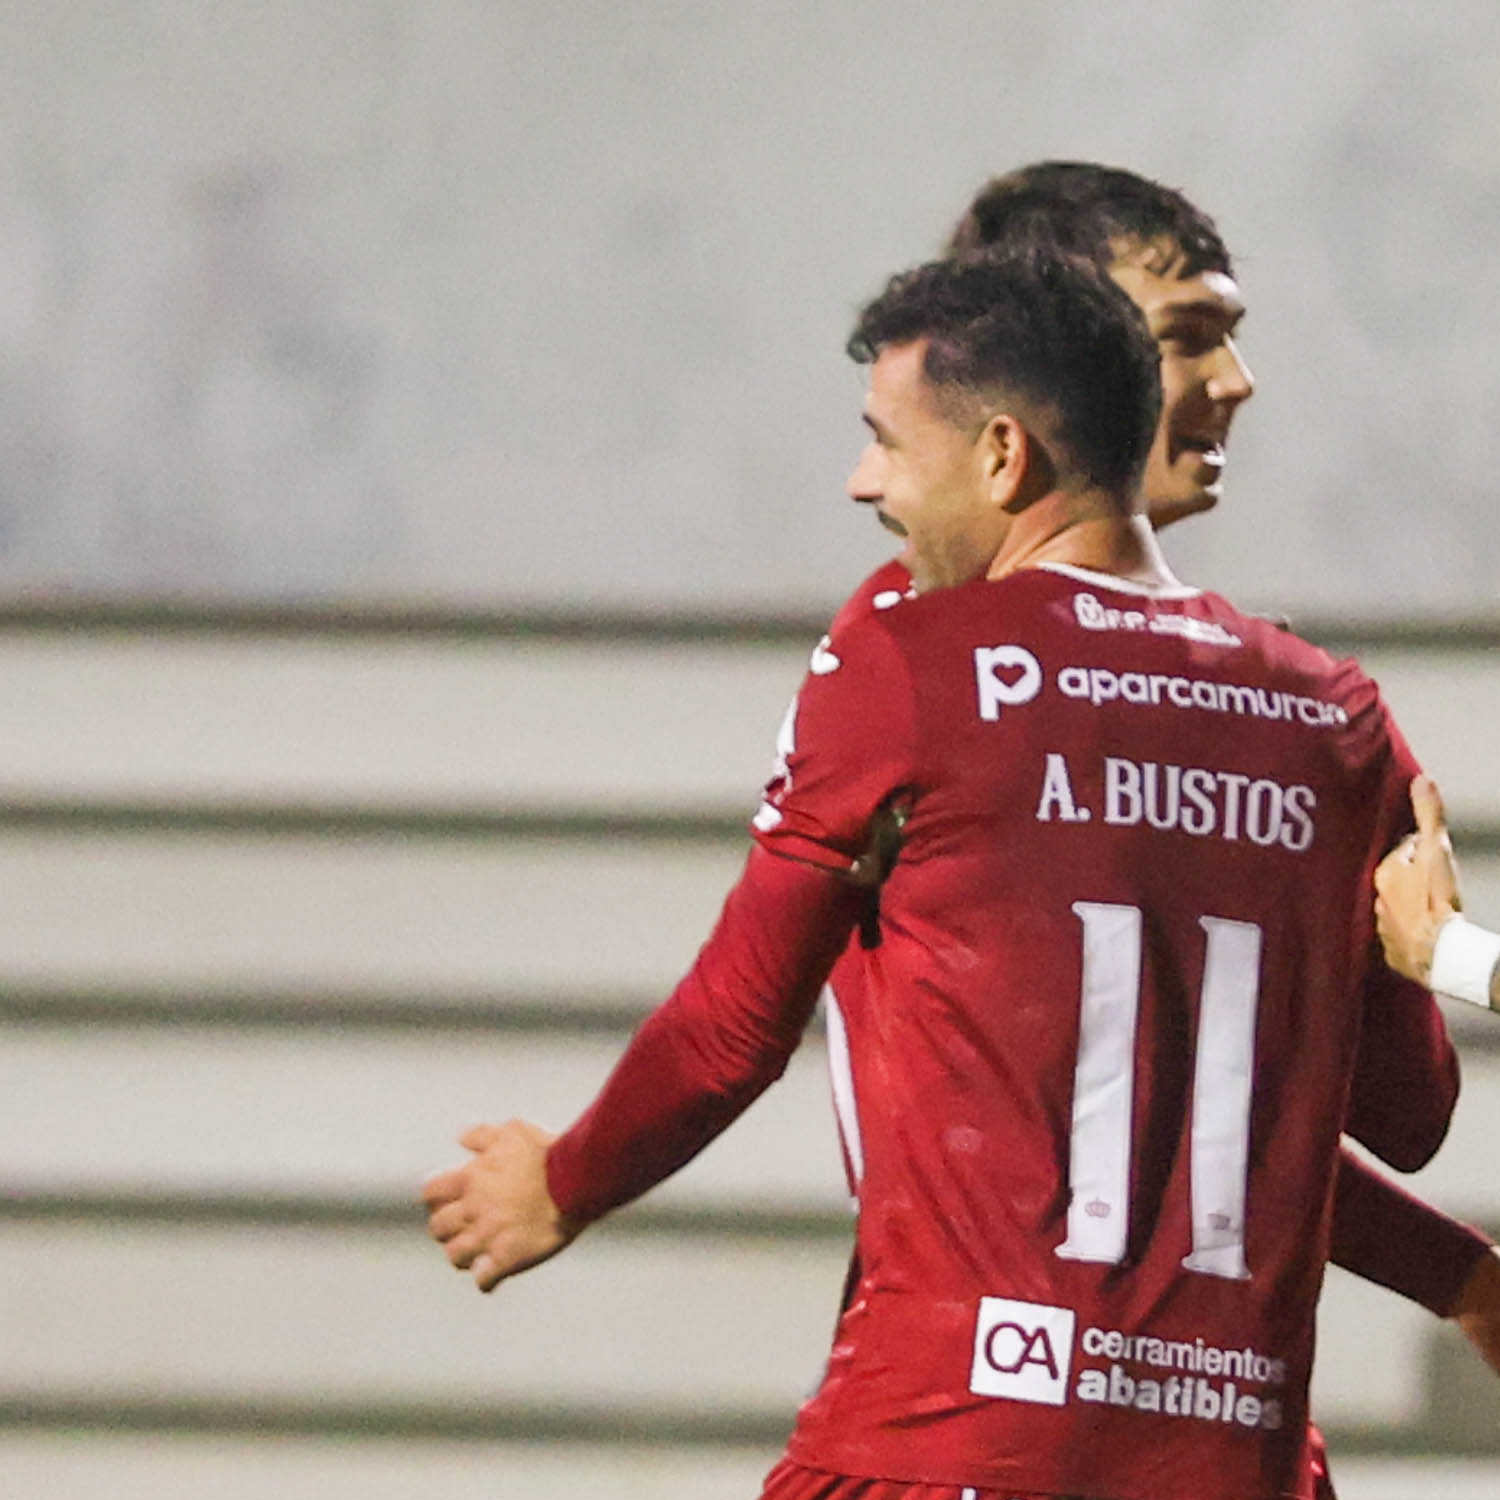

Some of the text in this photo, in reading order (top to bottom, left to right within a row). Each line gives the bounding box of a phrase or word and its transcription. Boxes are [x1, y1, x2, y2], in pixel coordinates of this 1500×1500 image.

[1036, 753, 1317, 852] A. BUSTOS
[1054, 900, 1263, 1281] 11
[984, 1320, 1286, 1384] CA cerramientos
[1076, 1364, 1284, 1430] abatibles
